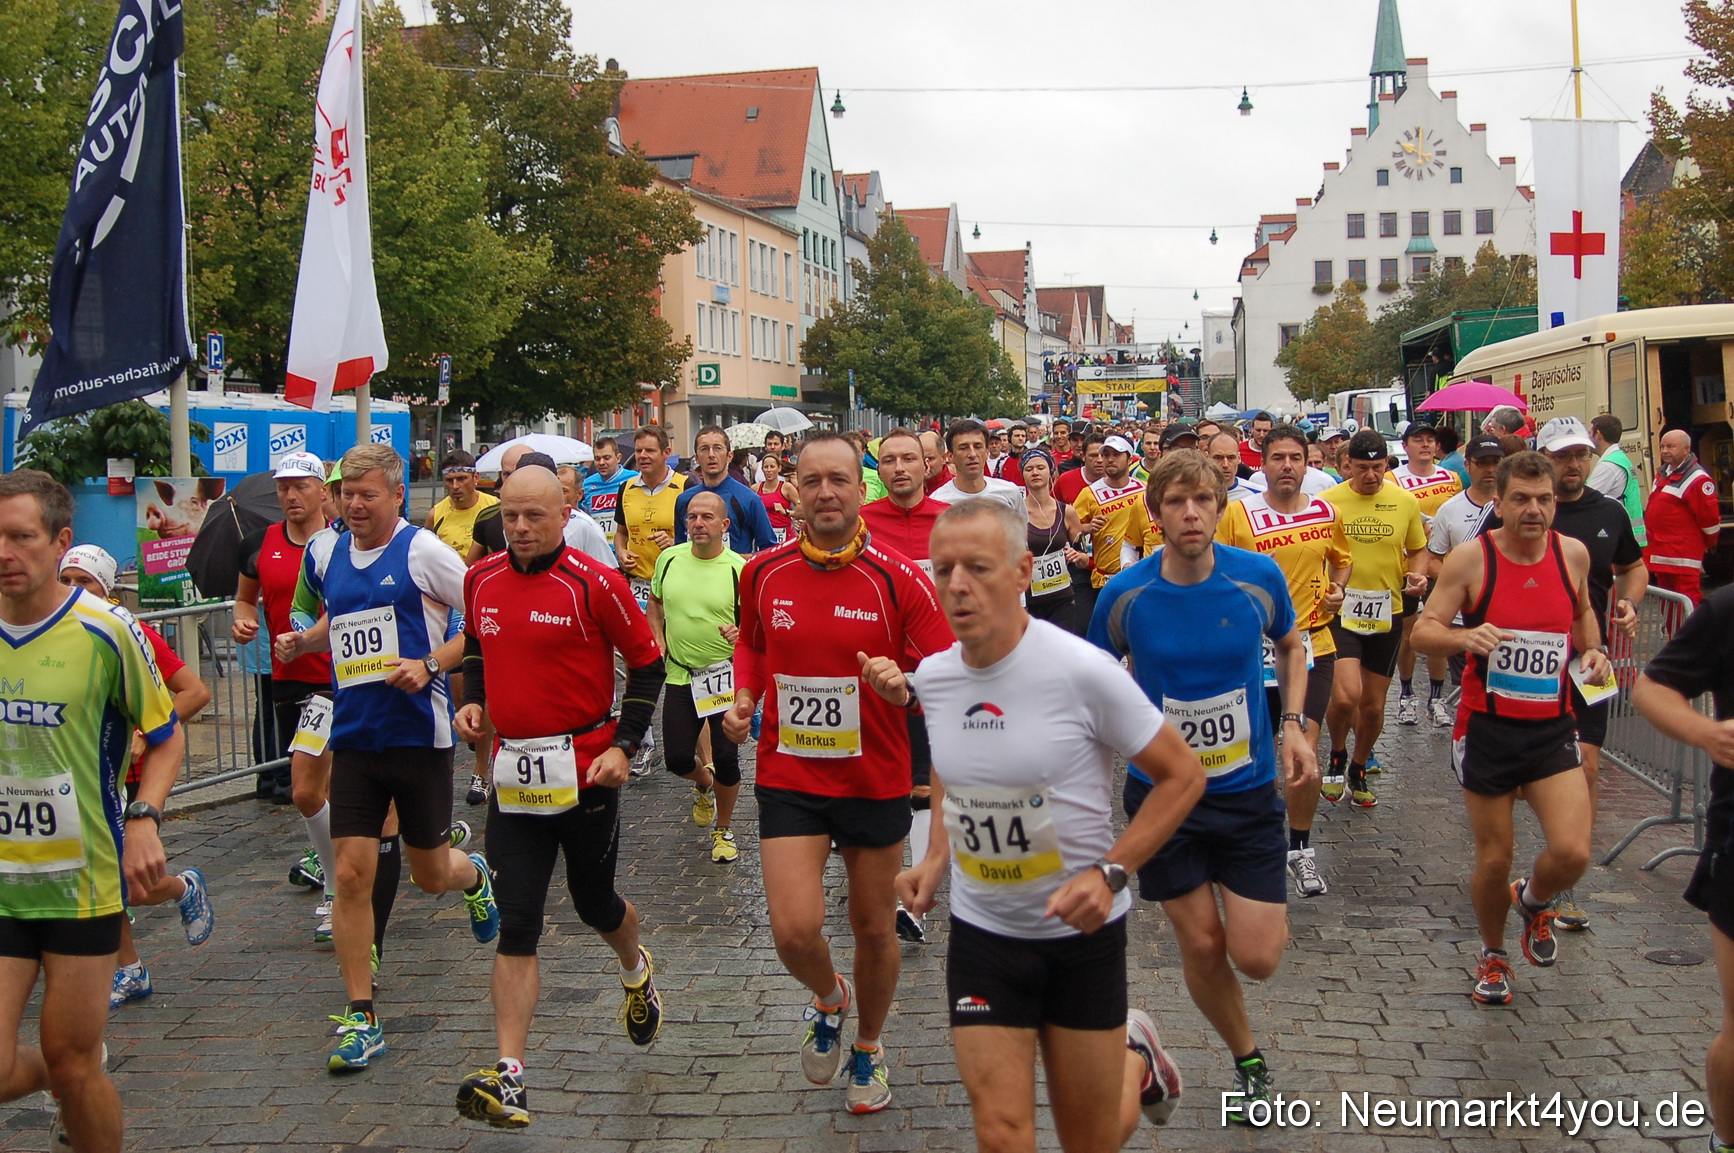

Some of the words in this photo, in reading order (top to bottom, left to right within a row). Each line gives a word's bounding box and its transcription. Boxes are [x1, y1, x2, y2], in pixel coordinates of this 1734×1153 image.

[211, 338, 220, 366] P
[442, 360, 449, 381] P
[701, 366, 716, 383] D
[1532, 363, 1581, 391] Bayerisches
[1105, 383, 1136, 391] START
[1531, 394, 1555, 413] Rotes
[1101, 501, 1125, 515] MAX
[1255, 533, 1293, 552] MAX
[146, 551, 169, 562] BEIDE
[1038, 560, 1062, 579] 189
[834, 605, 878, 622] Markus
[1352, 601, 1383, 618] 447
[348, 615, 382, 628] Neumarkt
[529, 610, 572, 627] Robert
[341, 626, 383, 659] 309
[1520, 637, 1555, 647] Neumarkt
[344, 660, 382, 676] Winfried
[1496, 645, 1559, 675] 3086
[702, 671, 732, 694] 177
[801, 685, 842, 694] Neumarkt
[789, 696, 842, 727] 228
[1164, 705, 1192, 717] PARTL
[1194, 700, 1234, 716] Neumarkt
[962, 719, 1005, 730] skinfit
[1181, 713, 1235, 748] 299
[795, 733, 836, 747] Markus
[516, 755, 547, 785] 91
[6, 786, 54, 797] Neumarkt
[519, 791, 553, 804] Robert
[970, 798, 1024, 810] Neumarkt
[959, 814, 1031, 854] 314
[979, 863, 1022, 880] David
[956, 1003, 991, 1012] skinfit
